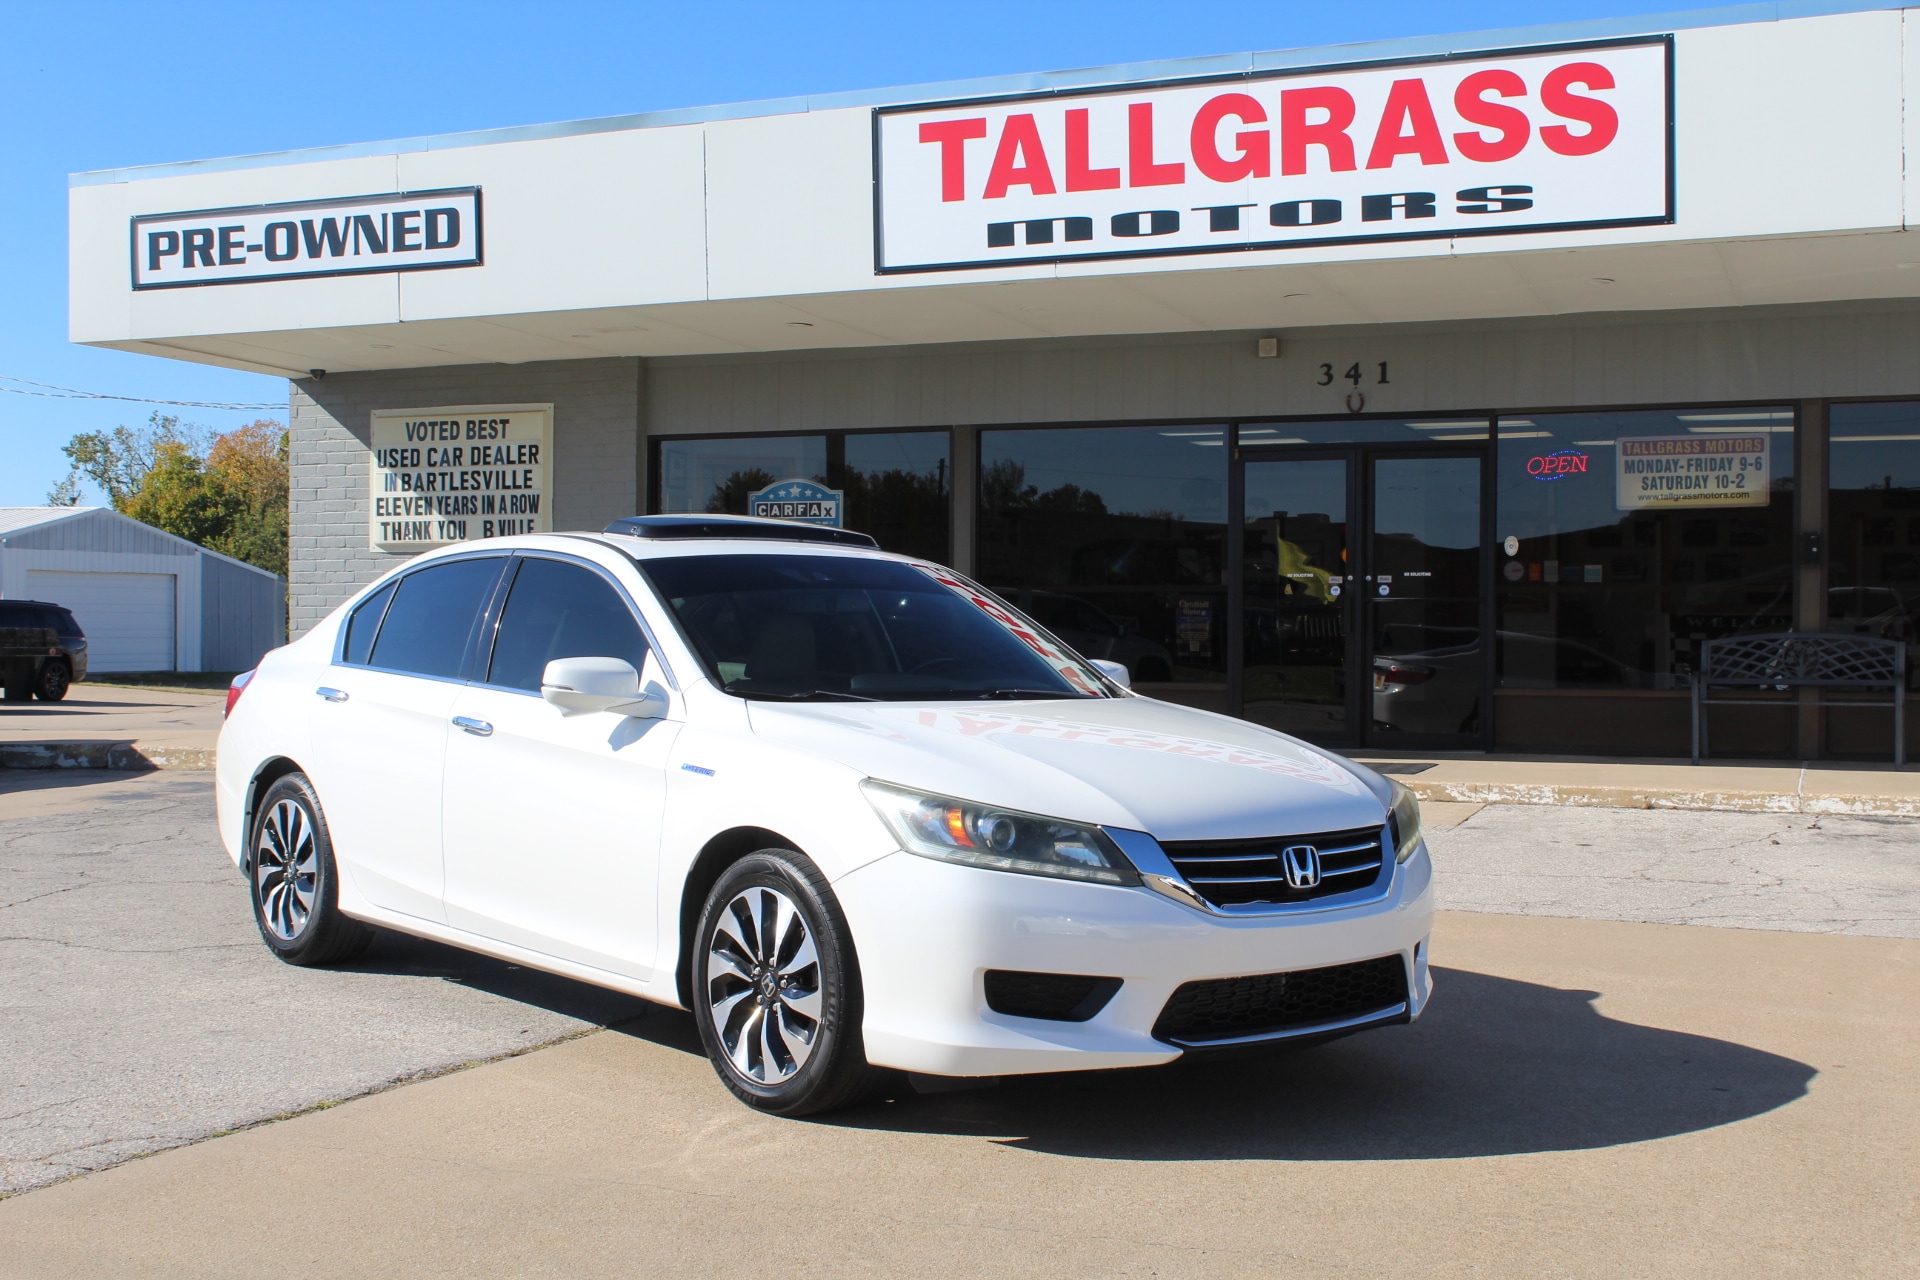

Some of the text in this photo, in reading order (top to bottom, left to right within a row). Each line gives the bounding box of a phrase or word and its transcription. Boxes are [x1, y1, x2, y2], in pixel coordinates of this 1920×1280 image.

[918, 61, 1619, 203] TALLGRASS
[147, 207, 461, 271] PRE-OWNED
[405, 418, 510, 441] VOTED BEST
[377, 444, 540, 468] USED CAR DEALER
[1625, 438, 1762, 455] TALLGRASS MOTORS
[1527, 455, 1588, 474] OPEN
[1623, 456, 1763, 475] MONDAY-FRIDAY 9-6
[384, 469, 533, 493] IN BARTLESVILLE
[1641, 473, 1746, 491] SATURDAY 10-2
[376, 493, 541, 517] ELEVEN YEARS IN A ROW
[1637, 491, 1750, 502] www.tallgrassmotors.com
[757, 502, 834, 518] CARFAX
[380, 520, 432, 541] THANK
[437, 520, 467, 541] YOU
